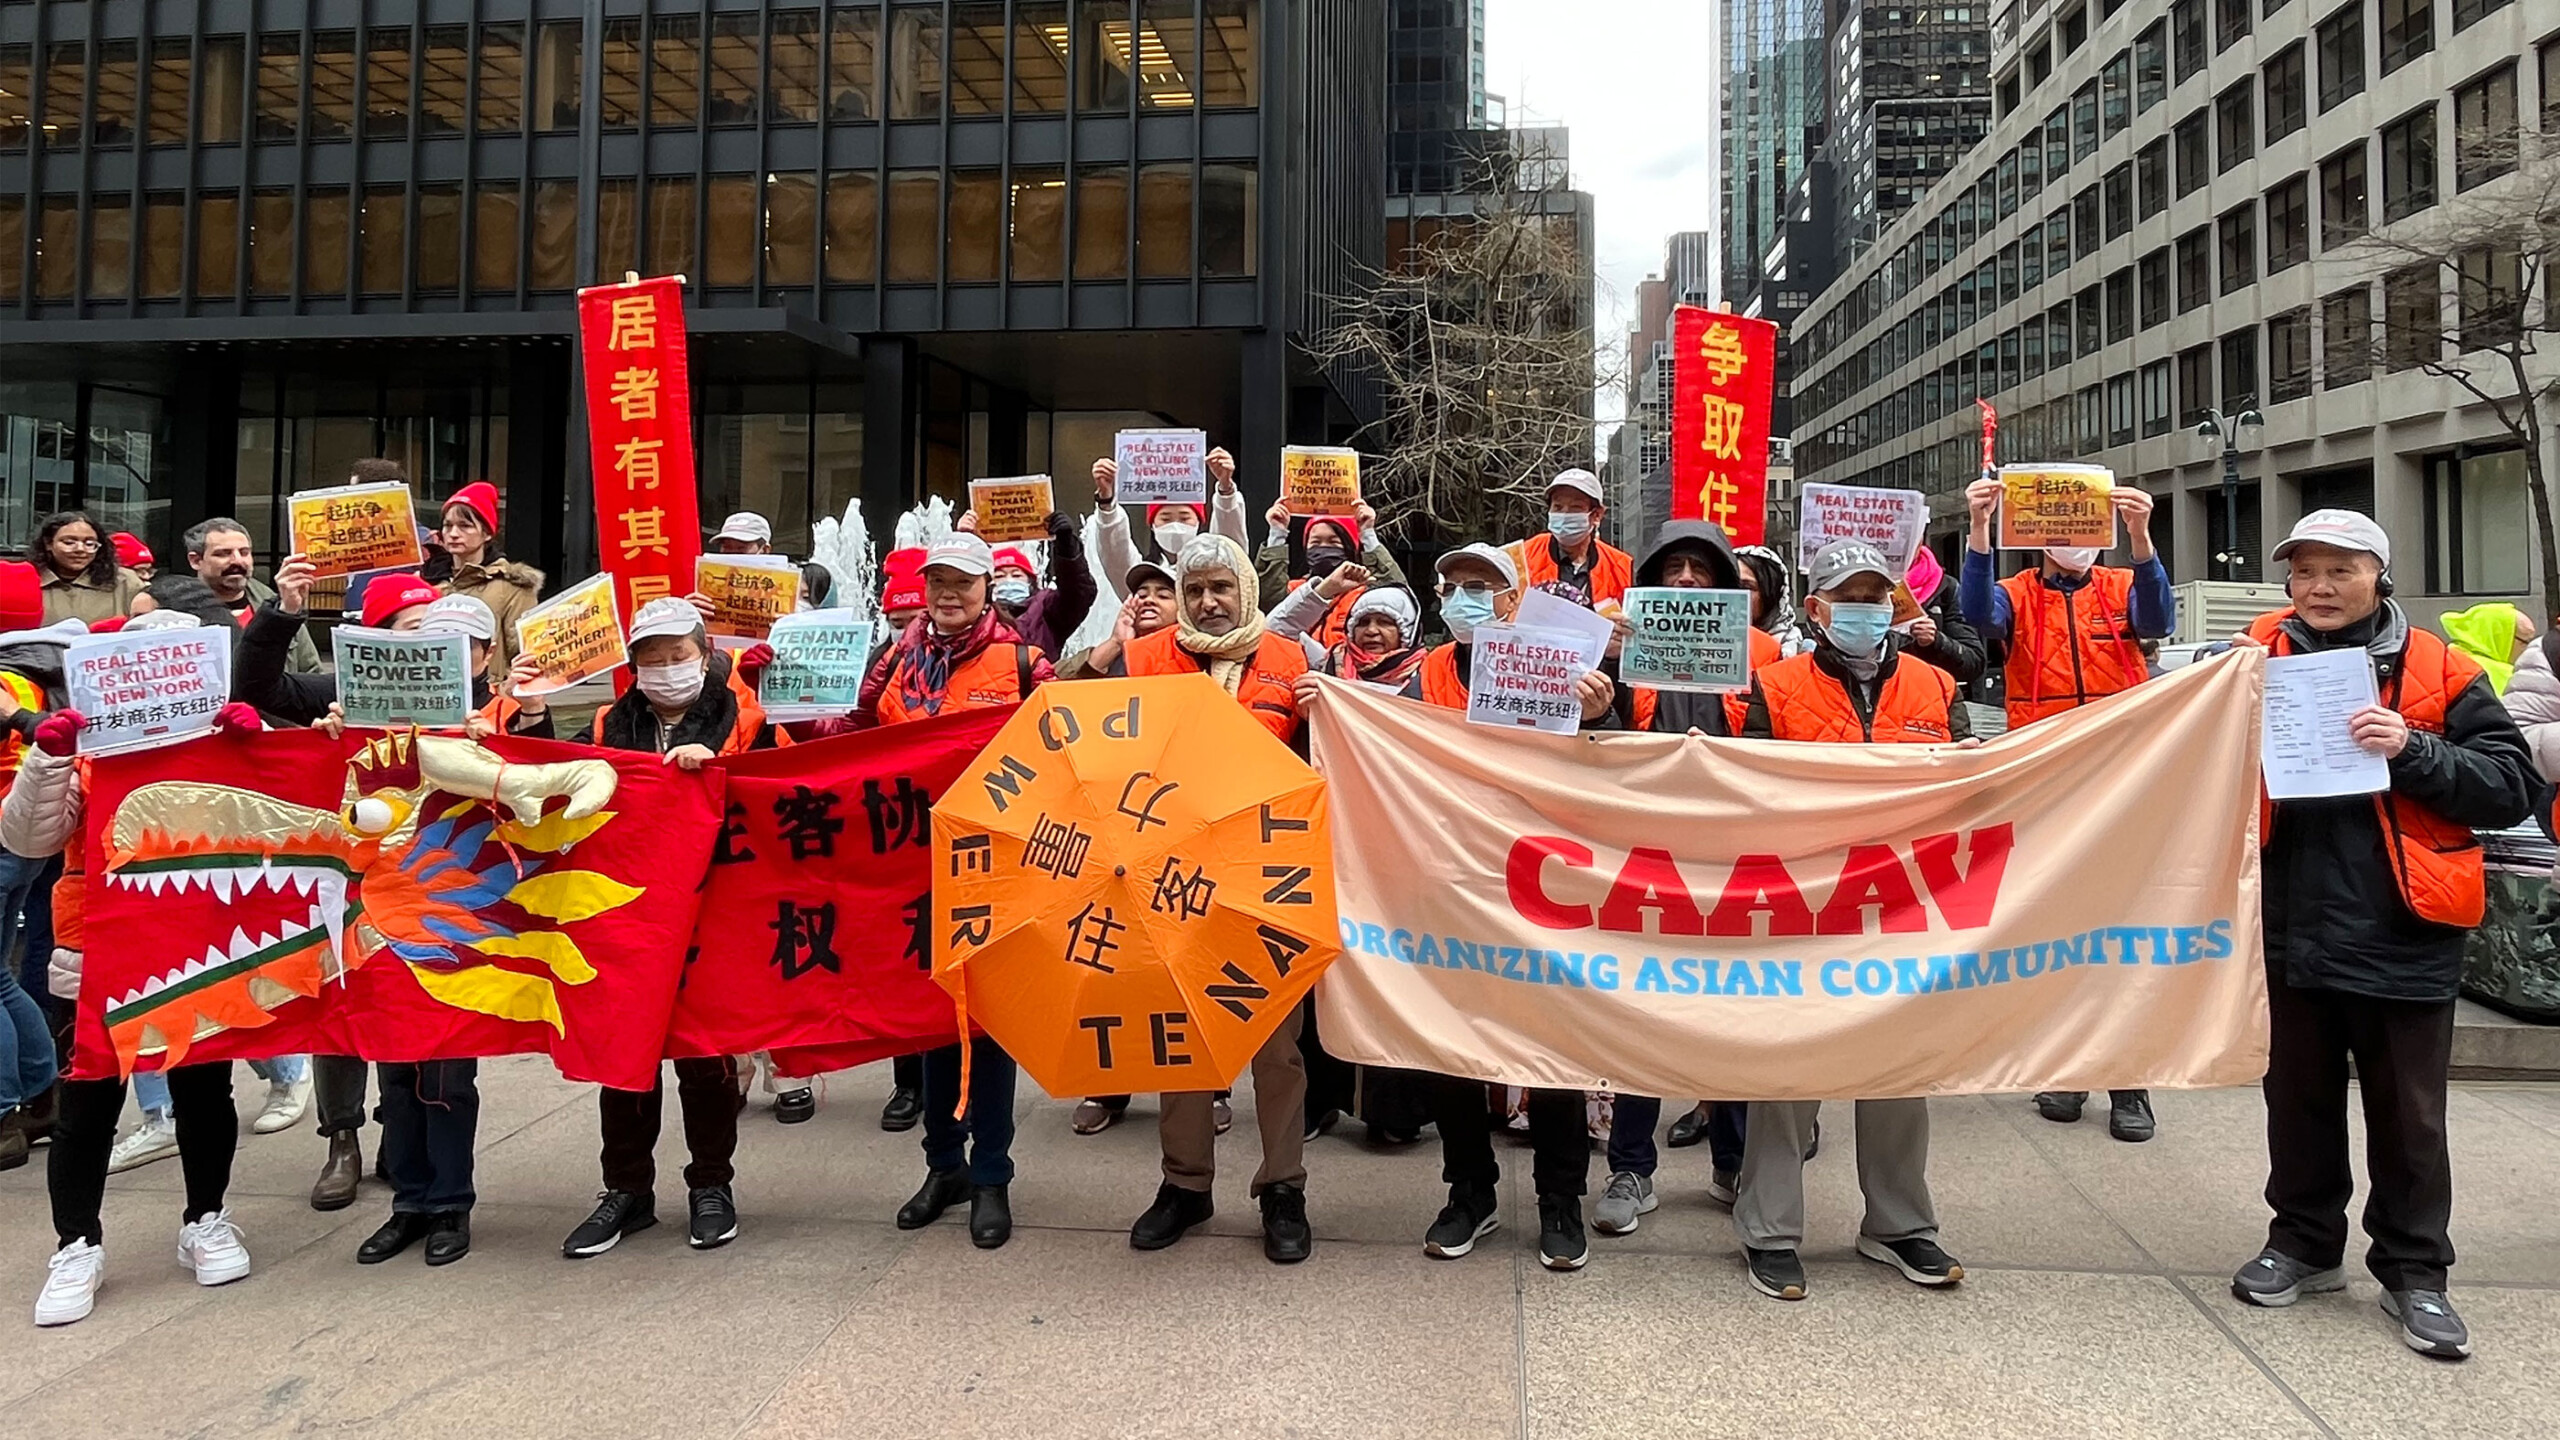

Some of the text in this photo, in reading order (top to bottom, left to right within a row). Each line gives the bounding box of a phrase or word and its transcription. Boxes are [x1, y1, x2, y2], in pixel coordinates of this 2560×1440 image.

[1699, 322, 1748, 536] 争取住
[1126, 443, 1196, 453] REAL ESTATE
[1133, 455, 1188, 465] IS KILLING
[1304, 459, 1336, 468] FIGHT
[1134, 467, 1190, 476] NEW YORK
[1292, 468, 1348, 476] TOGETHER
[1310, 477, 1331, 485] WIN
[2019, 480, 2087, 495] 一起抗争
[1290, 485, 1351, 495] TOGETHER!
[989, 496, 1034, 506] TENANT
[1815, 494, 1904, 511] REAL ESTATE
[309, 502, 382, 522] 一起抗争
[992, 506, 1034, 516] POWER!
[1822, 510, 1894, 525] IS KILLING
[1823, 525, 1895, 539] NEW YORK
[344, 541, 406, 556] TOGETHER
[1829, 546, 1882, 570] NYC
[712, 573, 776, 591] 一起抗争
[1639, 600, 1727, 616] TENANT
[1643, 618, 1721, 633] POWER
[554, 627, 578, 645] WIN
[777, 630, 859, 645] TENANT
[85, 642, 207, 673] REAL ESTATE
[345, 643, 447, 663] TENANT
[775, 647, 849, 662] POWER
[1488, 641, 1579, 664] REAL ESTATE
[99, 661, 198, 688] IS KILLING
[352, 663, 442, 681] POWER
[780, 664, 809, 672] SAVING
[1495, 659, 1568, 679] IS KILLING
[358, 682, 395, 691] SAVING
[767, 675, 813, 691] 住客力量
[1495, 676, 1570, 696] NEW YORK
[103, 677, 205, 706] NEW YORK
[344, 694, 461, 711] 住客力量 救纽约
[86, 694, 226, 734] 开发商杀死纽约
[1506, 821, 2014, 937] CAAAV
[1340, 916, 2234, 997] ORGANIZING ASIAN COMMUNITIES
